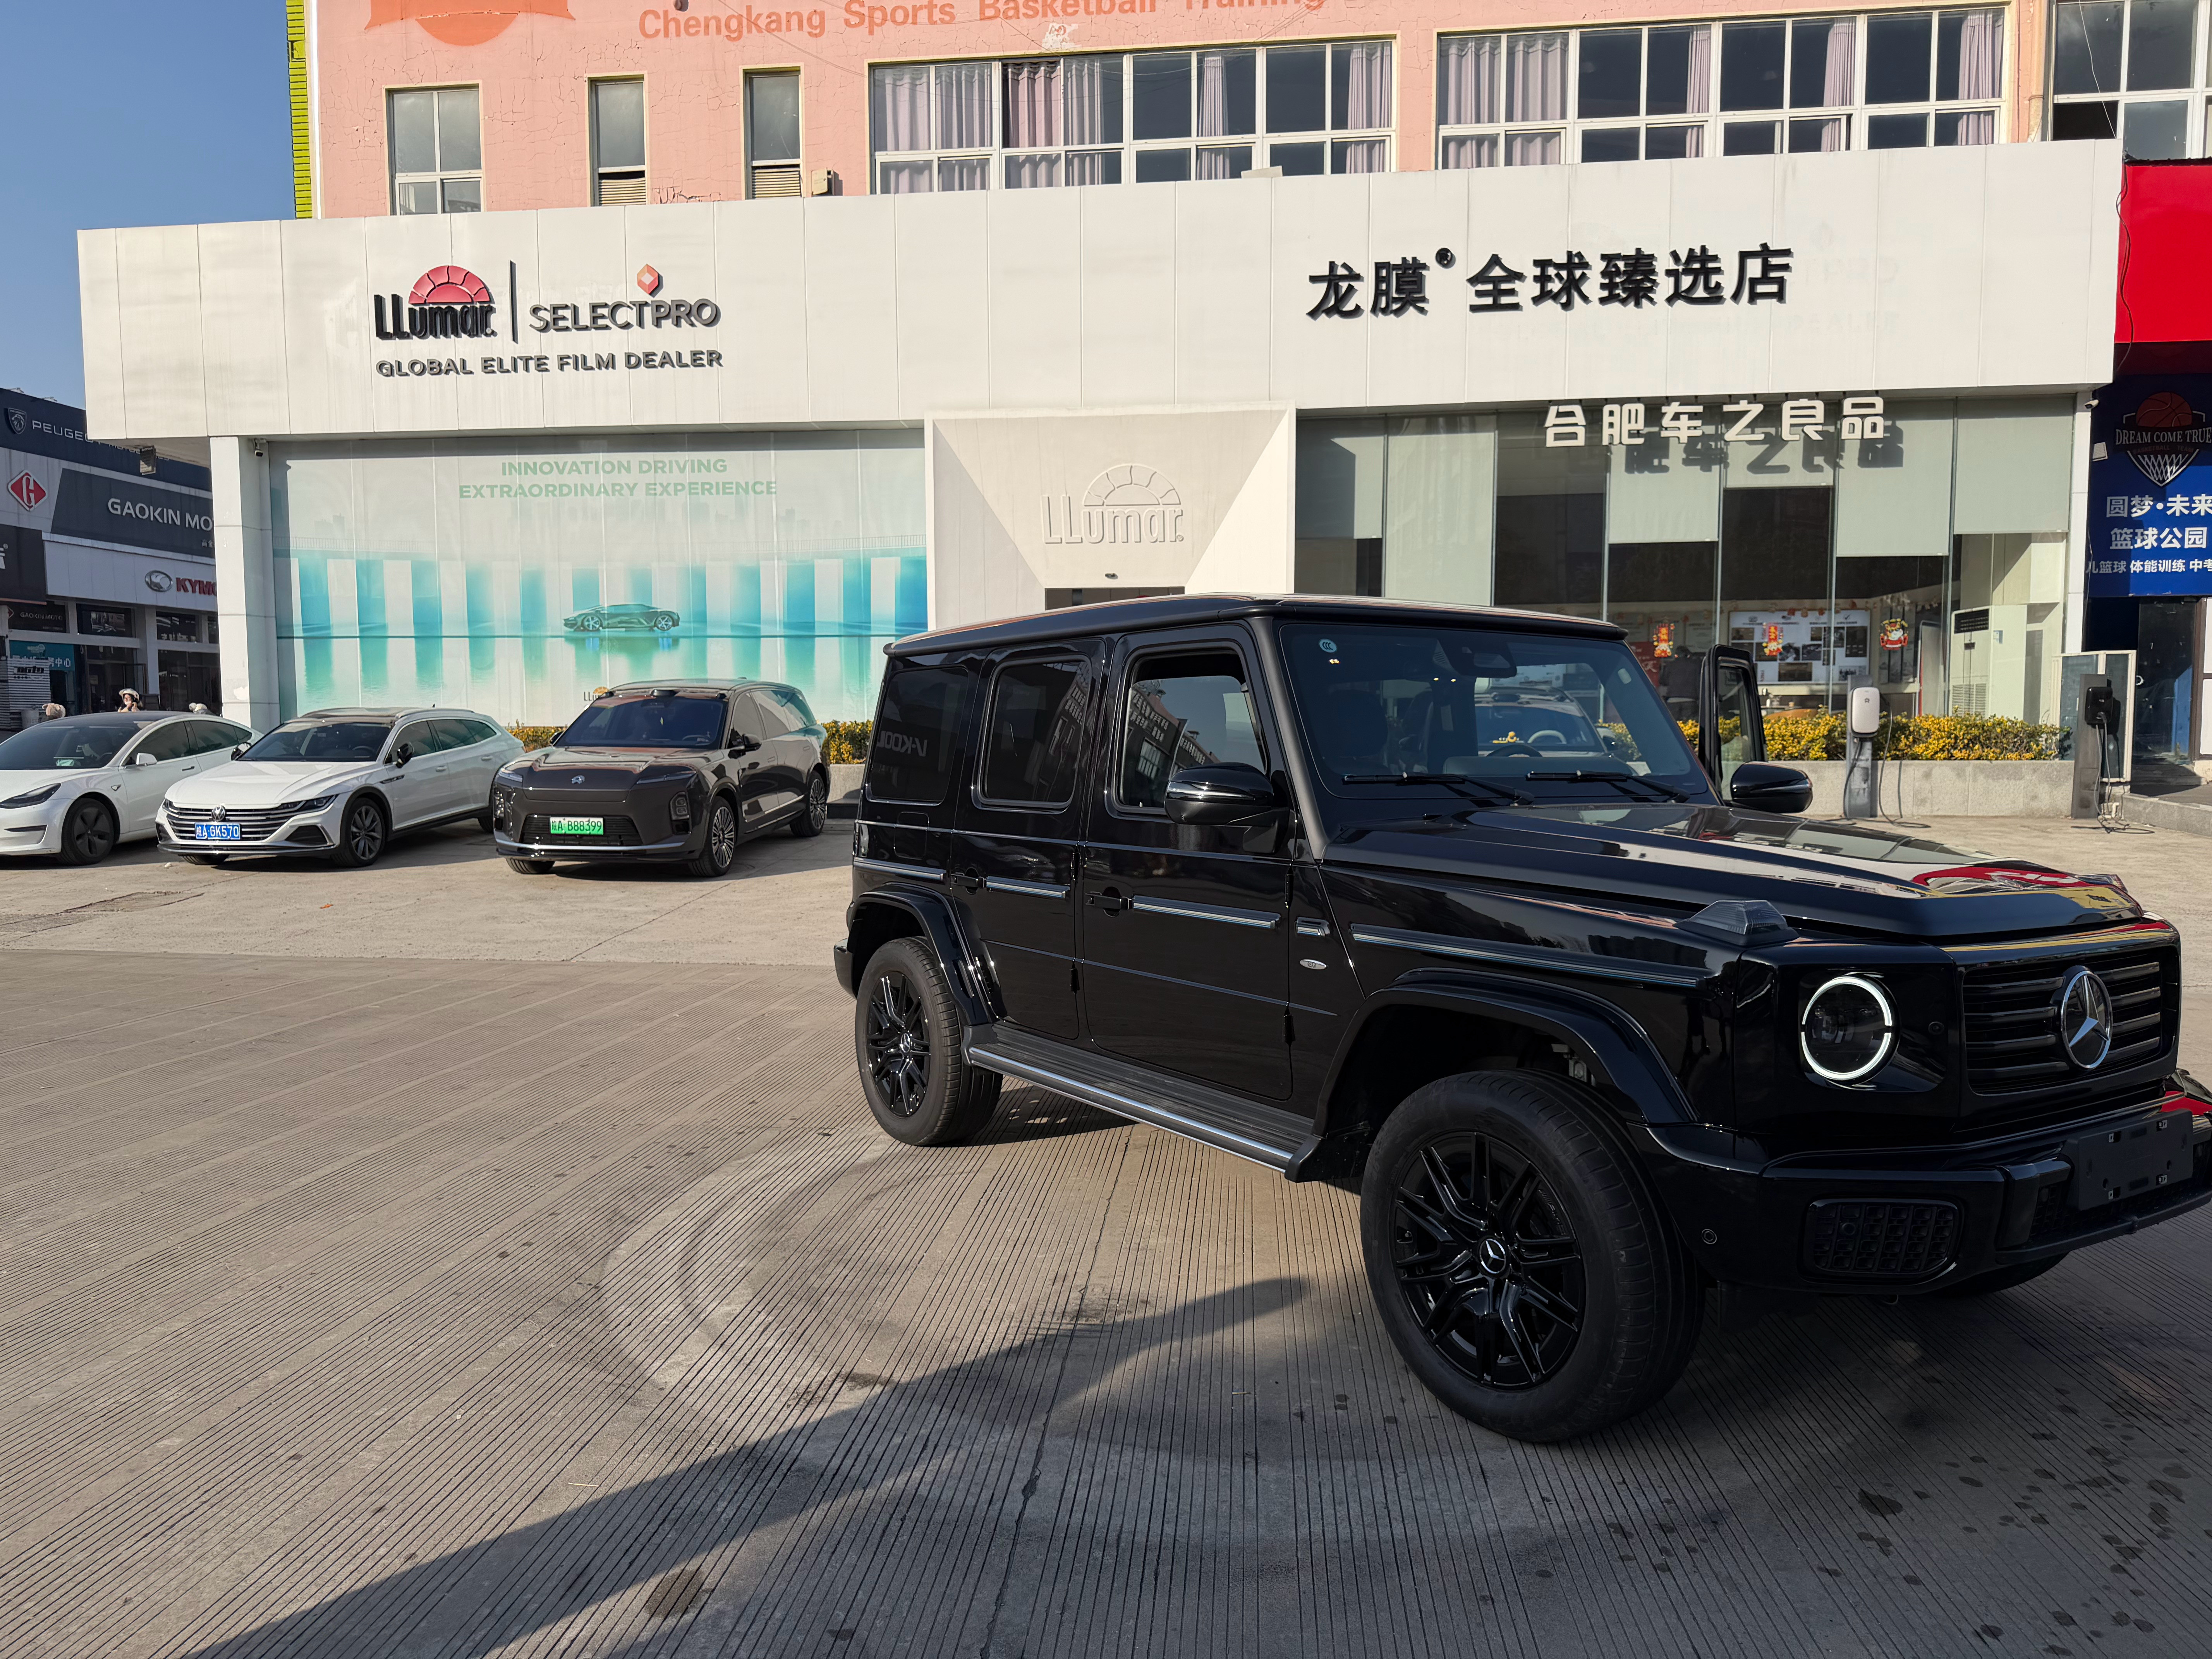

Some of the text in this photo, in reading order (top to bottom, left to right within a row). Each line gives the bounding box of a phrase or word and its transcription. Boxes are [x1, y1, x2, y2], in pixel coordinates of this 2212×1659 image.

[639, 5, 826, 41] Chengkang
[843, 0, 956, 35] Sports
[1467, 243, 1792, 312] 全球臻选店
[529, 298, 720, 332] SELECTPRO
[376, 349, 723, 378] GLOBAL ELITE FILM DEALER
[1544, 397, 1884, 447] 合肥车之良品
[2116, 427, 2212, 445] DREAM COME TRUE
[501, 459, 728, 476] INNOVATION DRIVING
[459, 481, 777, 499] EXTRAORDINARY EXPERIENCE
[108, 498, 180, 526] GAOKIN
[2109, 527, 2207, 550] 篮球公园
[2130, 559, 2186, 573] 体能训练
